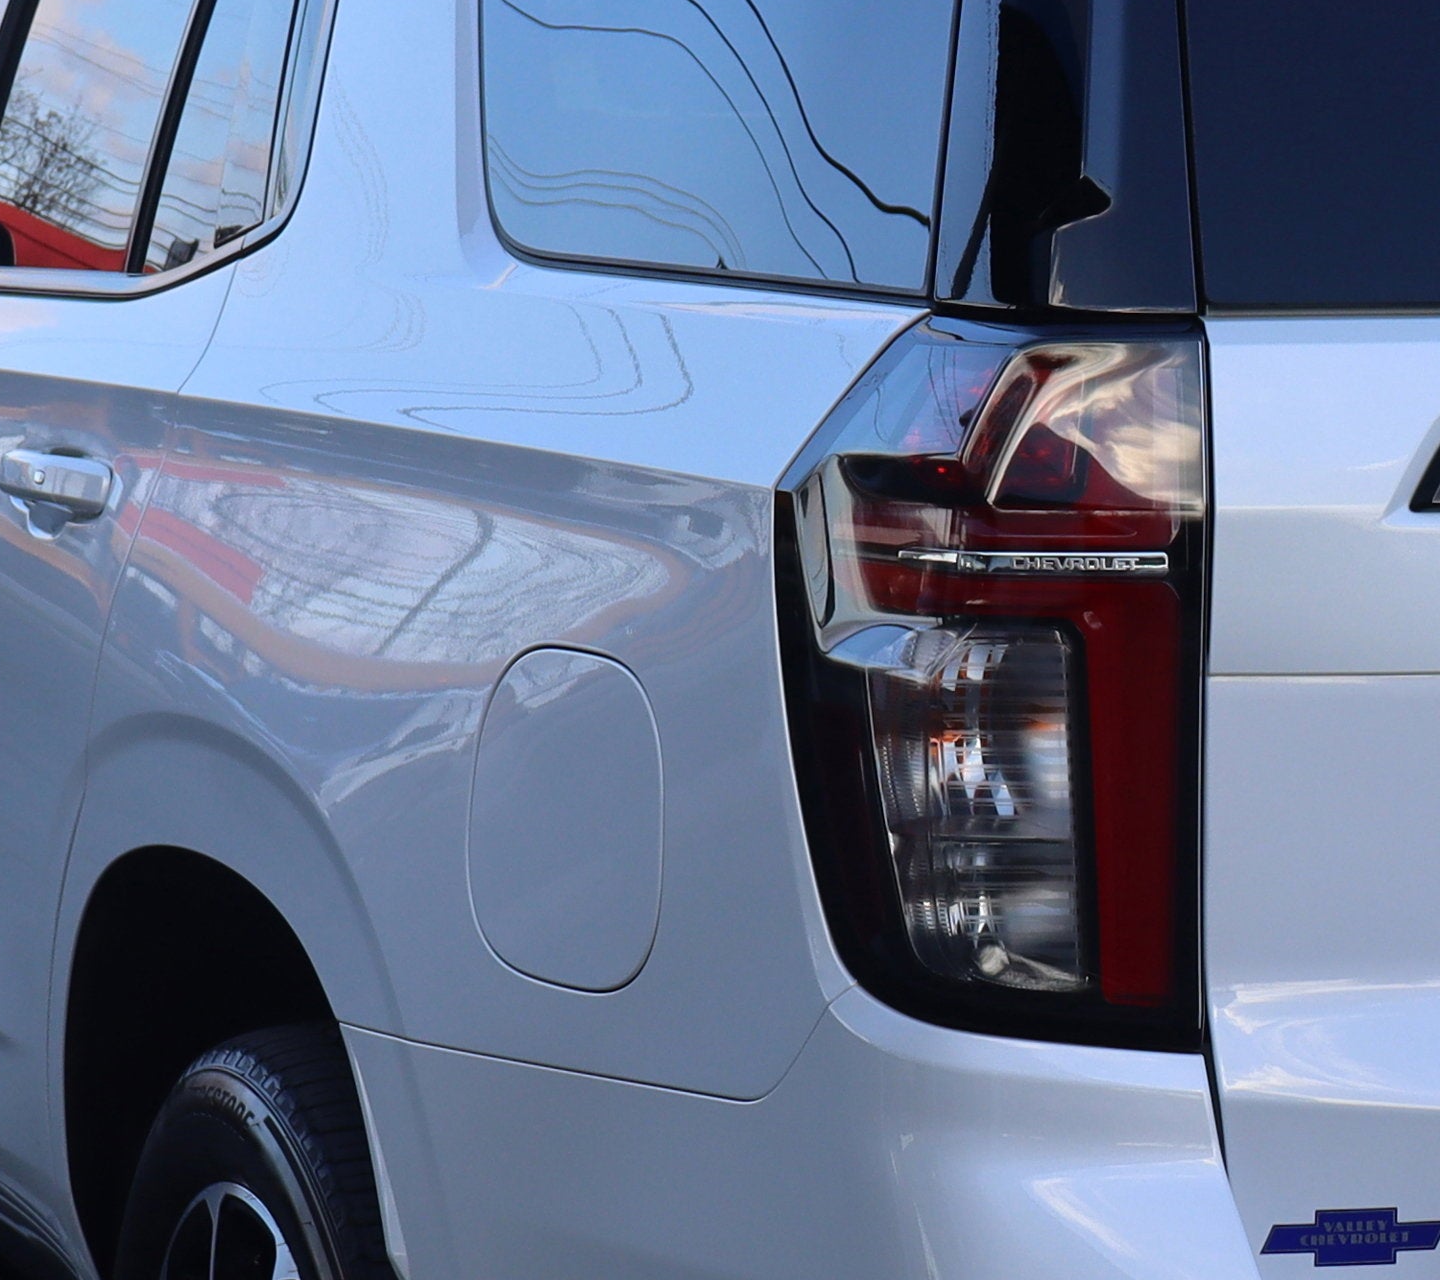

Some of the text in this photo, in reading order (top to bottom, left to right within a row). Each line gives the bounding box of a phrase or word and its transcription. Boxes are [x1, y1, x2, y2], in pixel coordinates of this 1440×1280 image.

[1012, 557, 1140, 571] CHEVROLET
[1323, 1220, 1389, 1233] VALLEY
[1299, 1231, 1410, 1246] CHEVROLET
